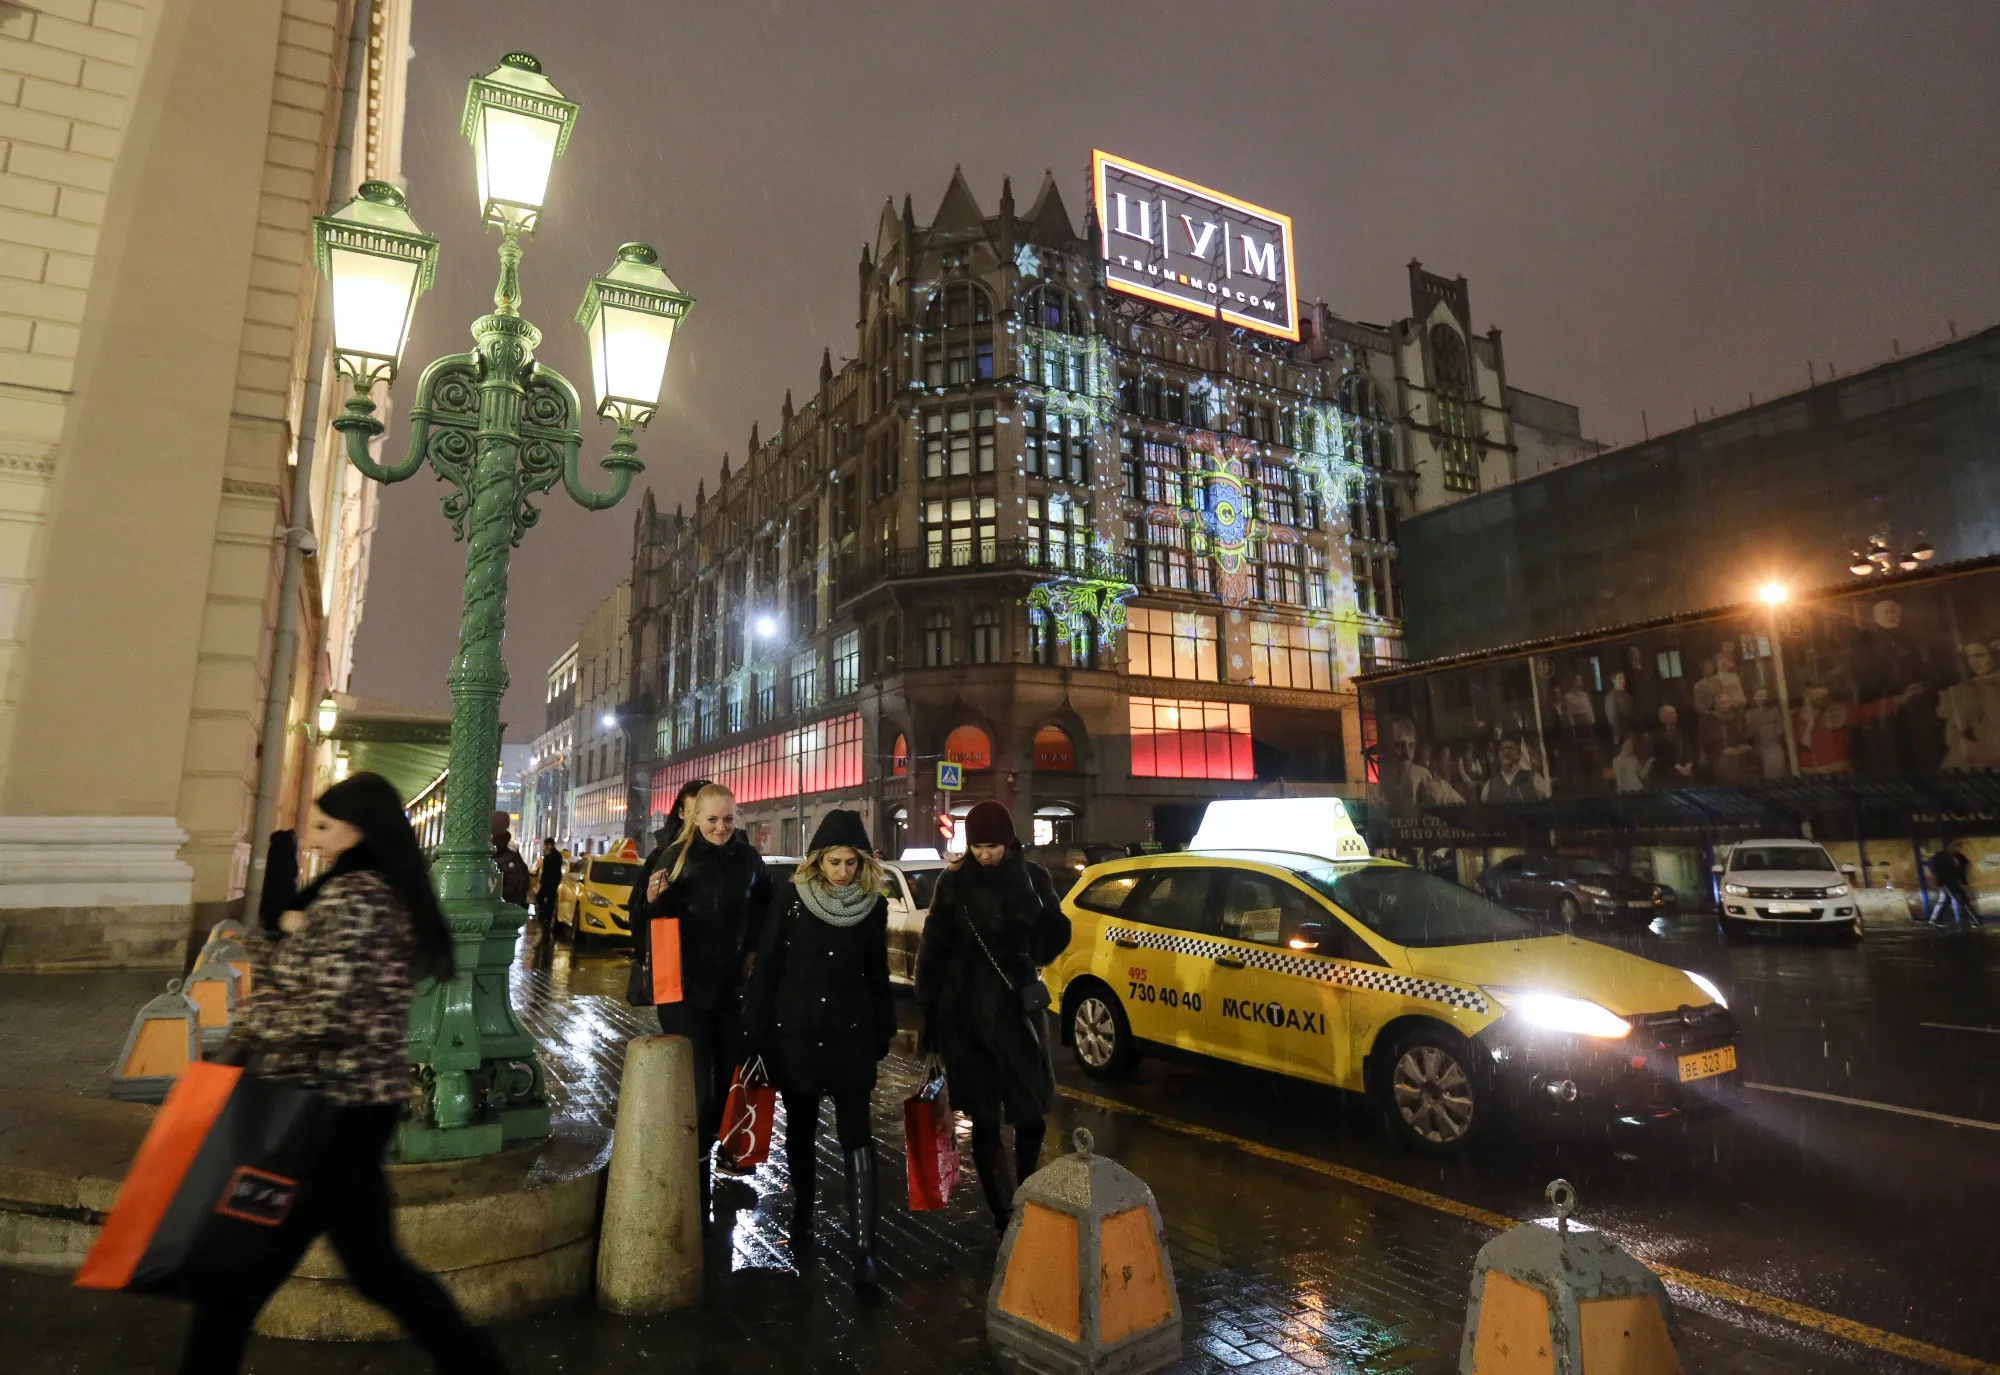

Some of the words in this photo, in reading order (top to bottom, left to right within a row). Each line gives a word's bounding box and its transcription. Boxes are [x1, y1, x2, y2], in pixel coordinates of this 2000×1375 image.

[1118, 255, 1176, 281] TSUM
[1190, 278, 1276, 311] MOSCOW
[1128, 966, 1147, 981] 495
[1128, 982, 1156, 1004] 730
[1159, 987, 1178, 1008] 40
[1181, 991, 1201, 1012] 40
[1702, 1053, 1719, 1073] 323
